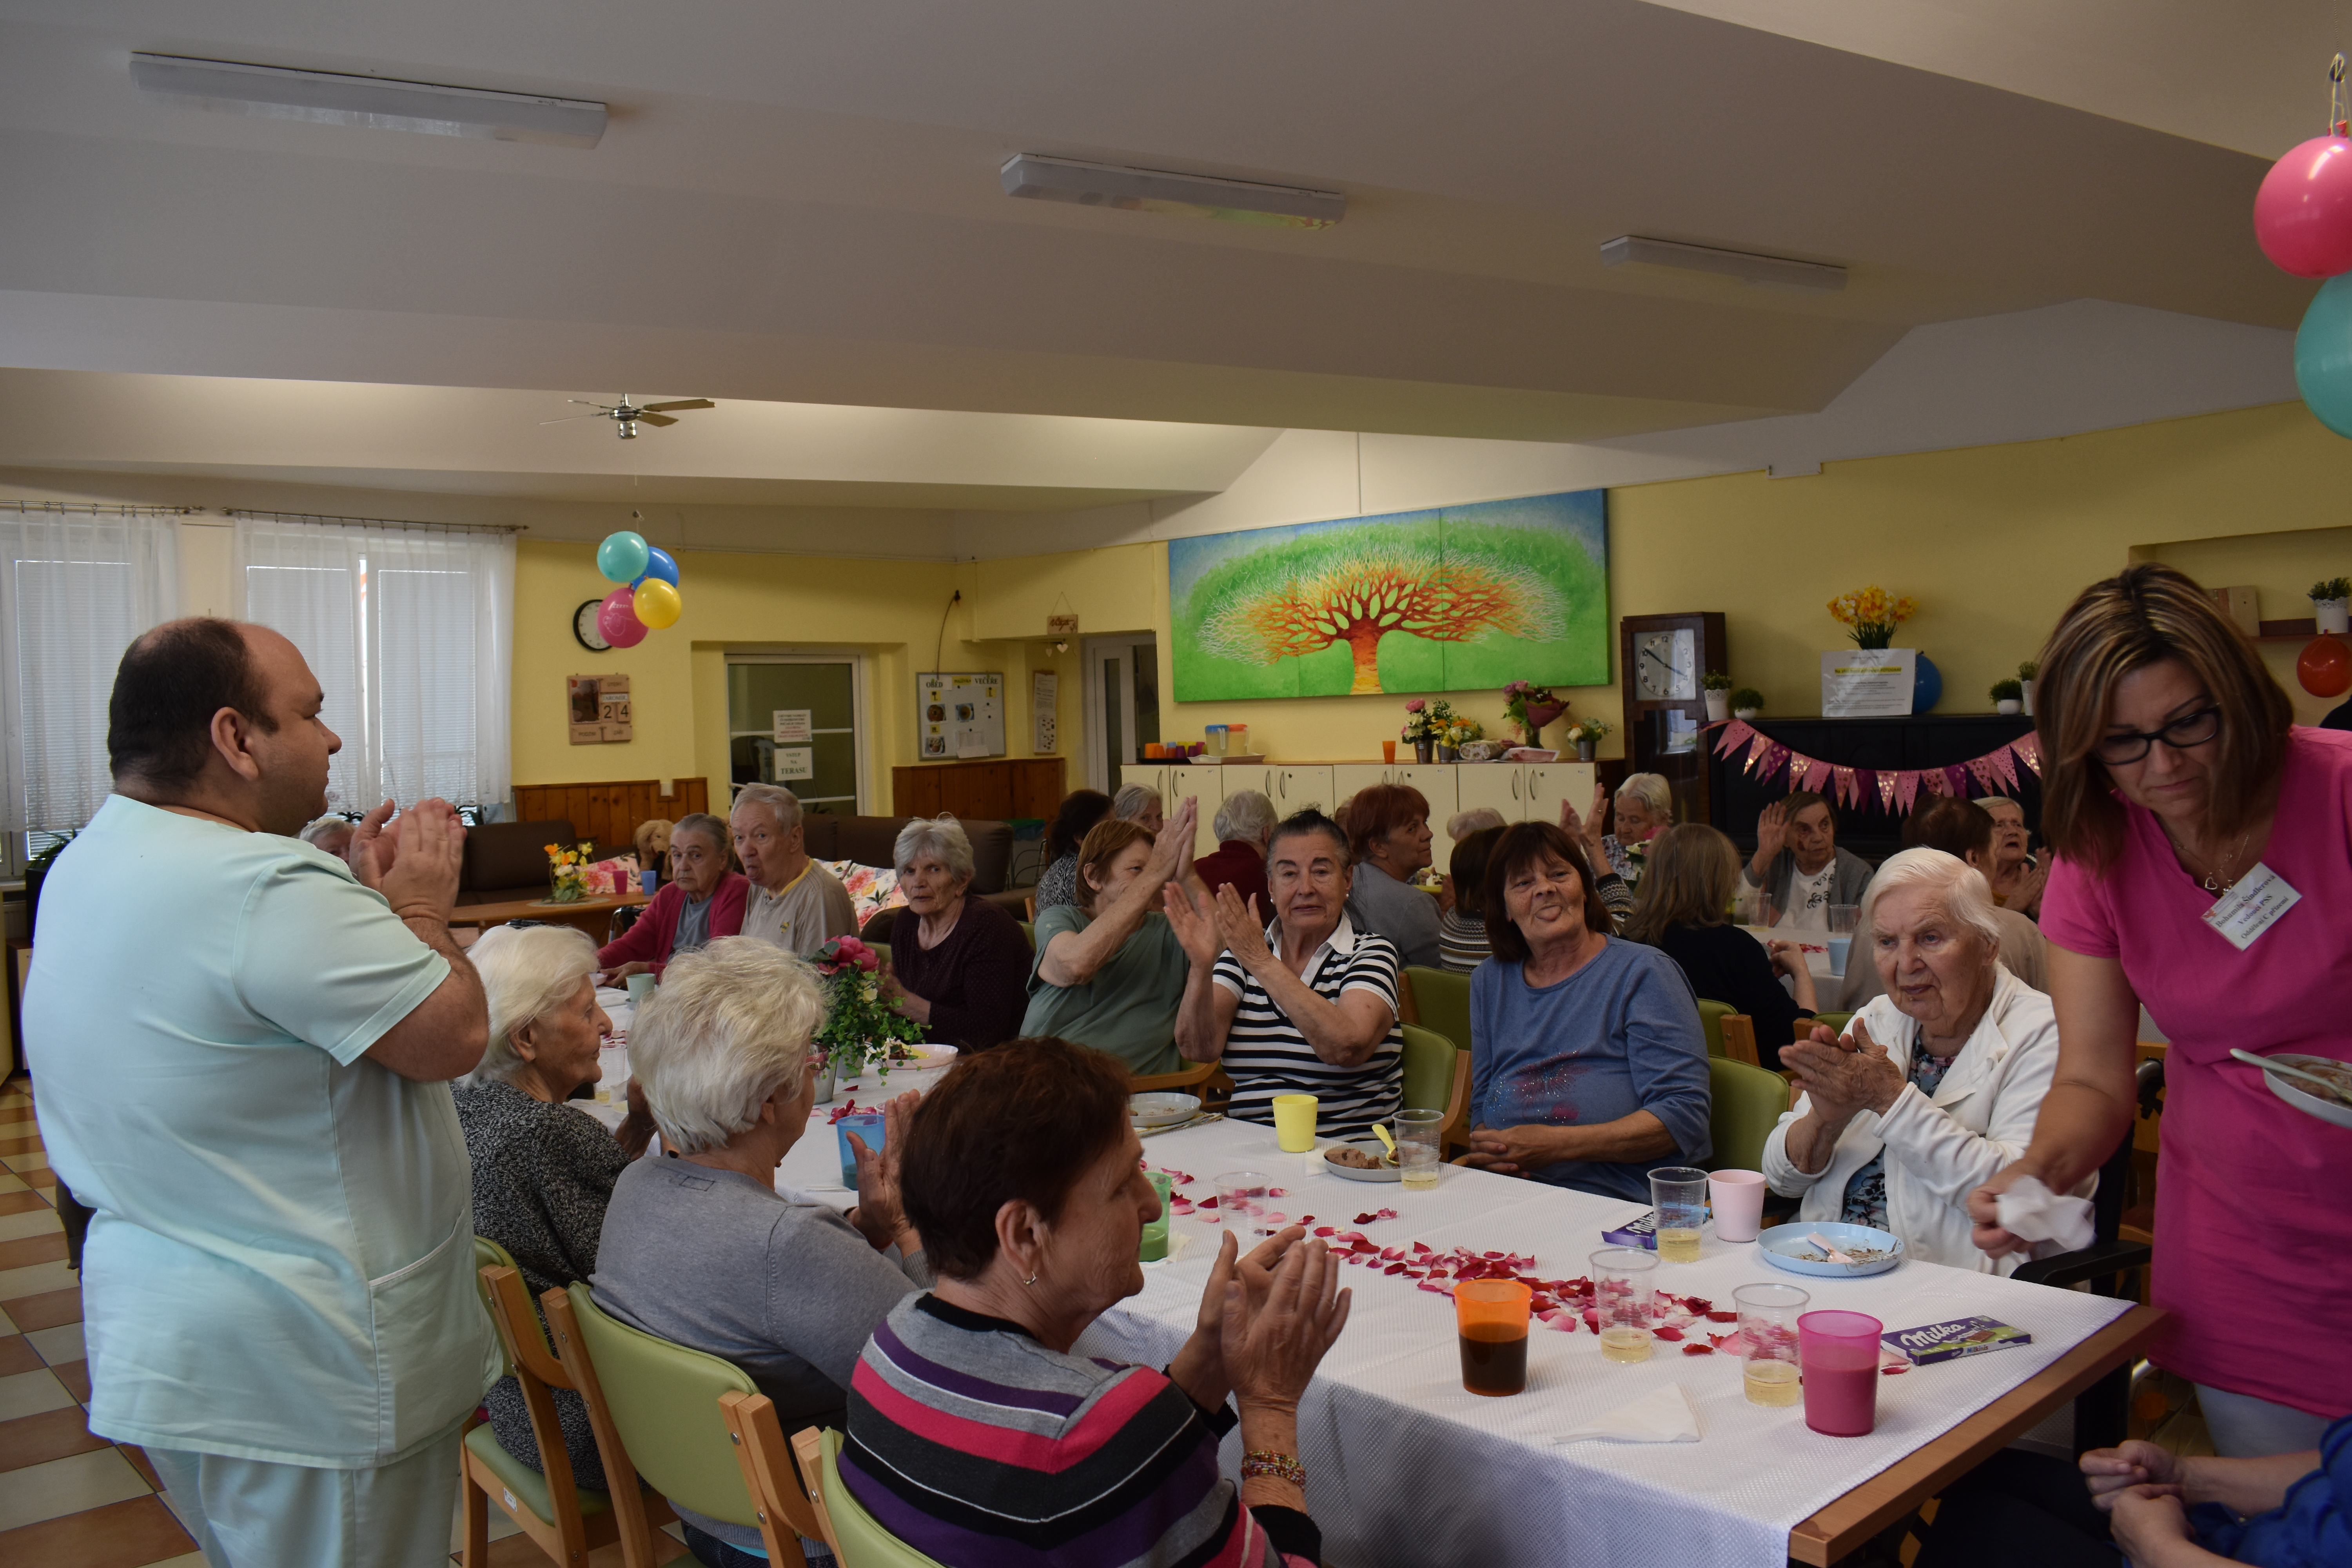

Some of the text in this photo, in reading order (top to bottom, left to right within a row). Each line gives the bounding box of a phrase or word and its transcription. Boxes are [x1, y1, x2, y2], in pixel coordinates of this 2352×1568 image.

[604, 704, 628, 719] 2 4
[2259, 894, 2272, 906] PSS
[2269, 896, 2288, 916] přízemí
[2216, 903, 2245, 927] Bohumila
[1900, 1324, 1965, 1347] Milka
